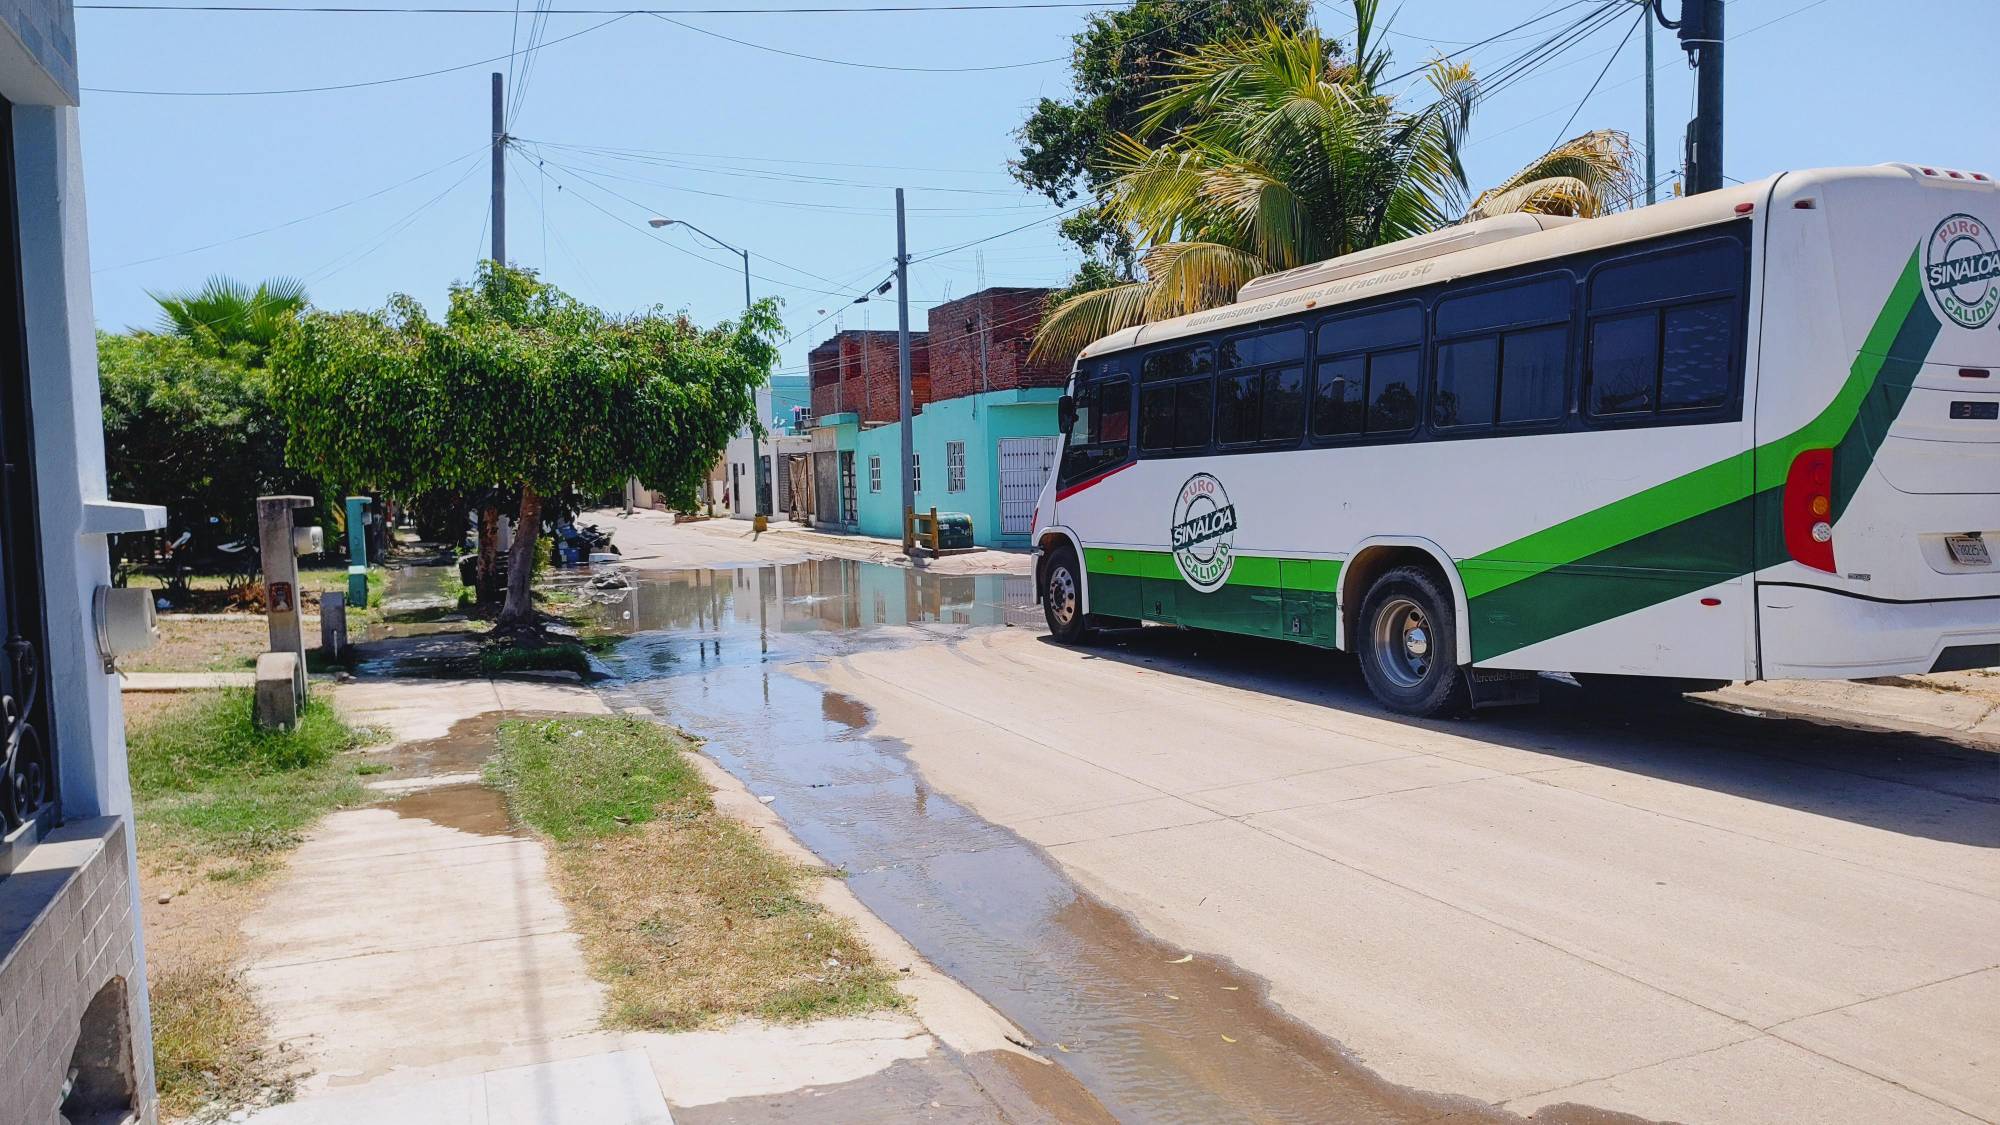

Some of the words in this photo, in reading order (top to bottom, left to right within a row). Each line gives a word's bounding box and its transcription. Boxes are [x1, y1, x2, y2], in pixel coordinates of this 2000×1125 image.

[1939, 221, 1980, 243] PURO
[1930, 253, 2000, 286] SINALOA
[1186, 302, 1275, 328] Autotransportes
[1325, 281, 1348, 296] del
[1944, 286, 1998, 322] CALIDAD
[1183, 479, 1214, 504] PURO
[1174, 508, 1233, 546] SINALOA
[1185, 544, 1229, 579] CALIDAD
